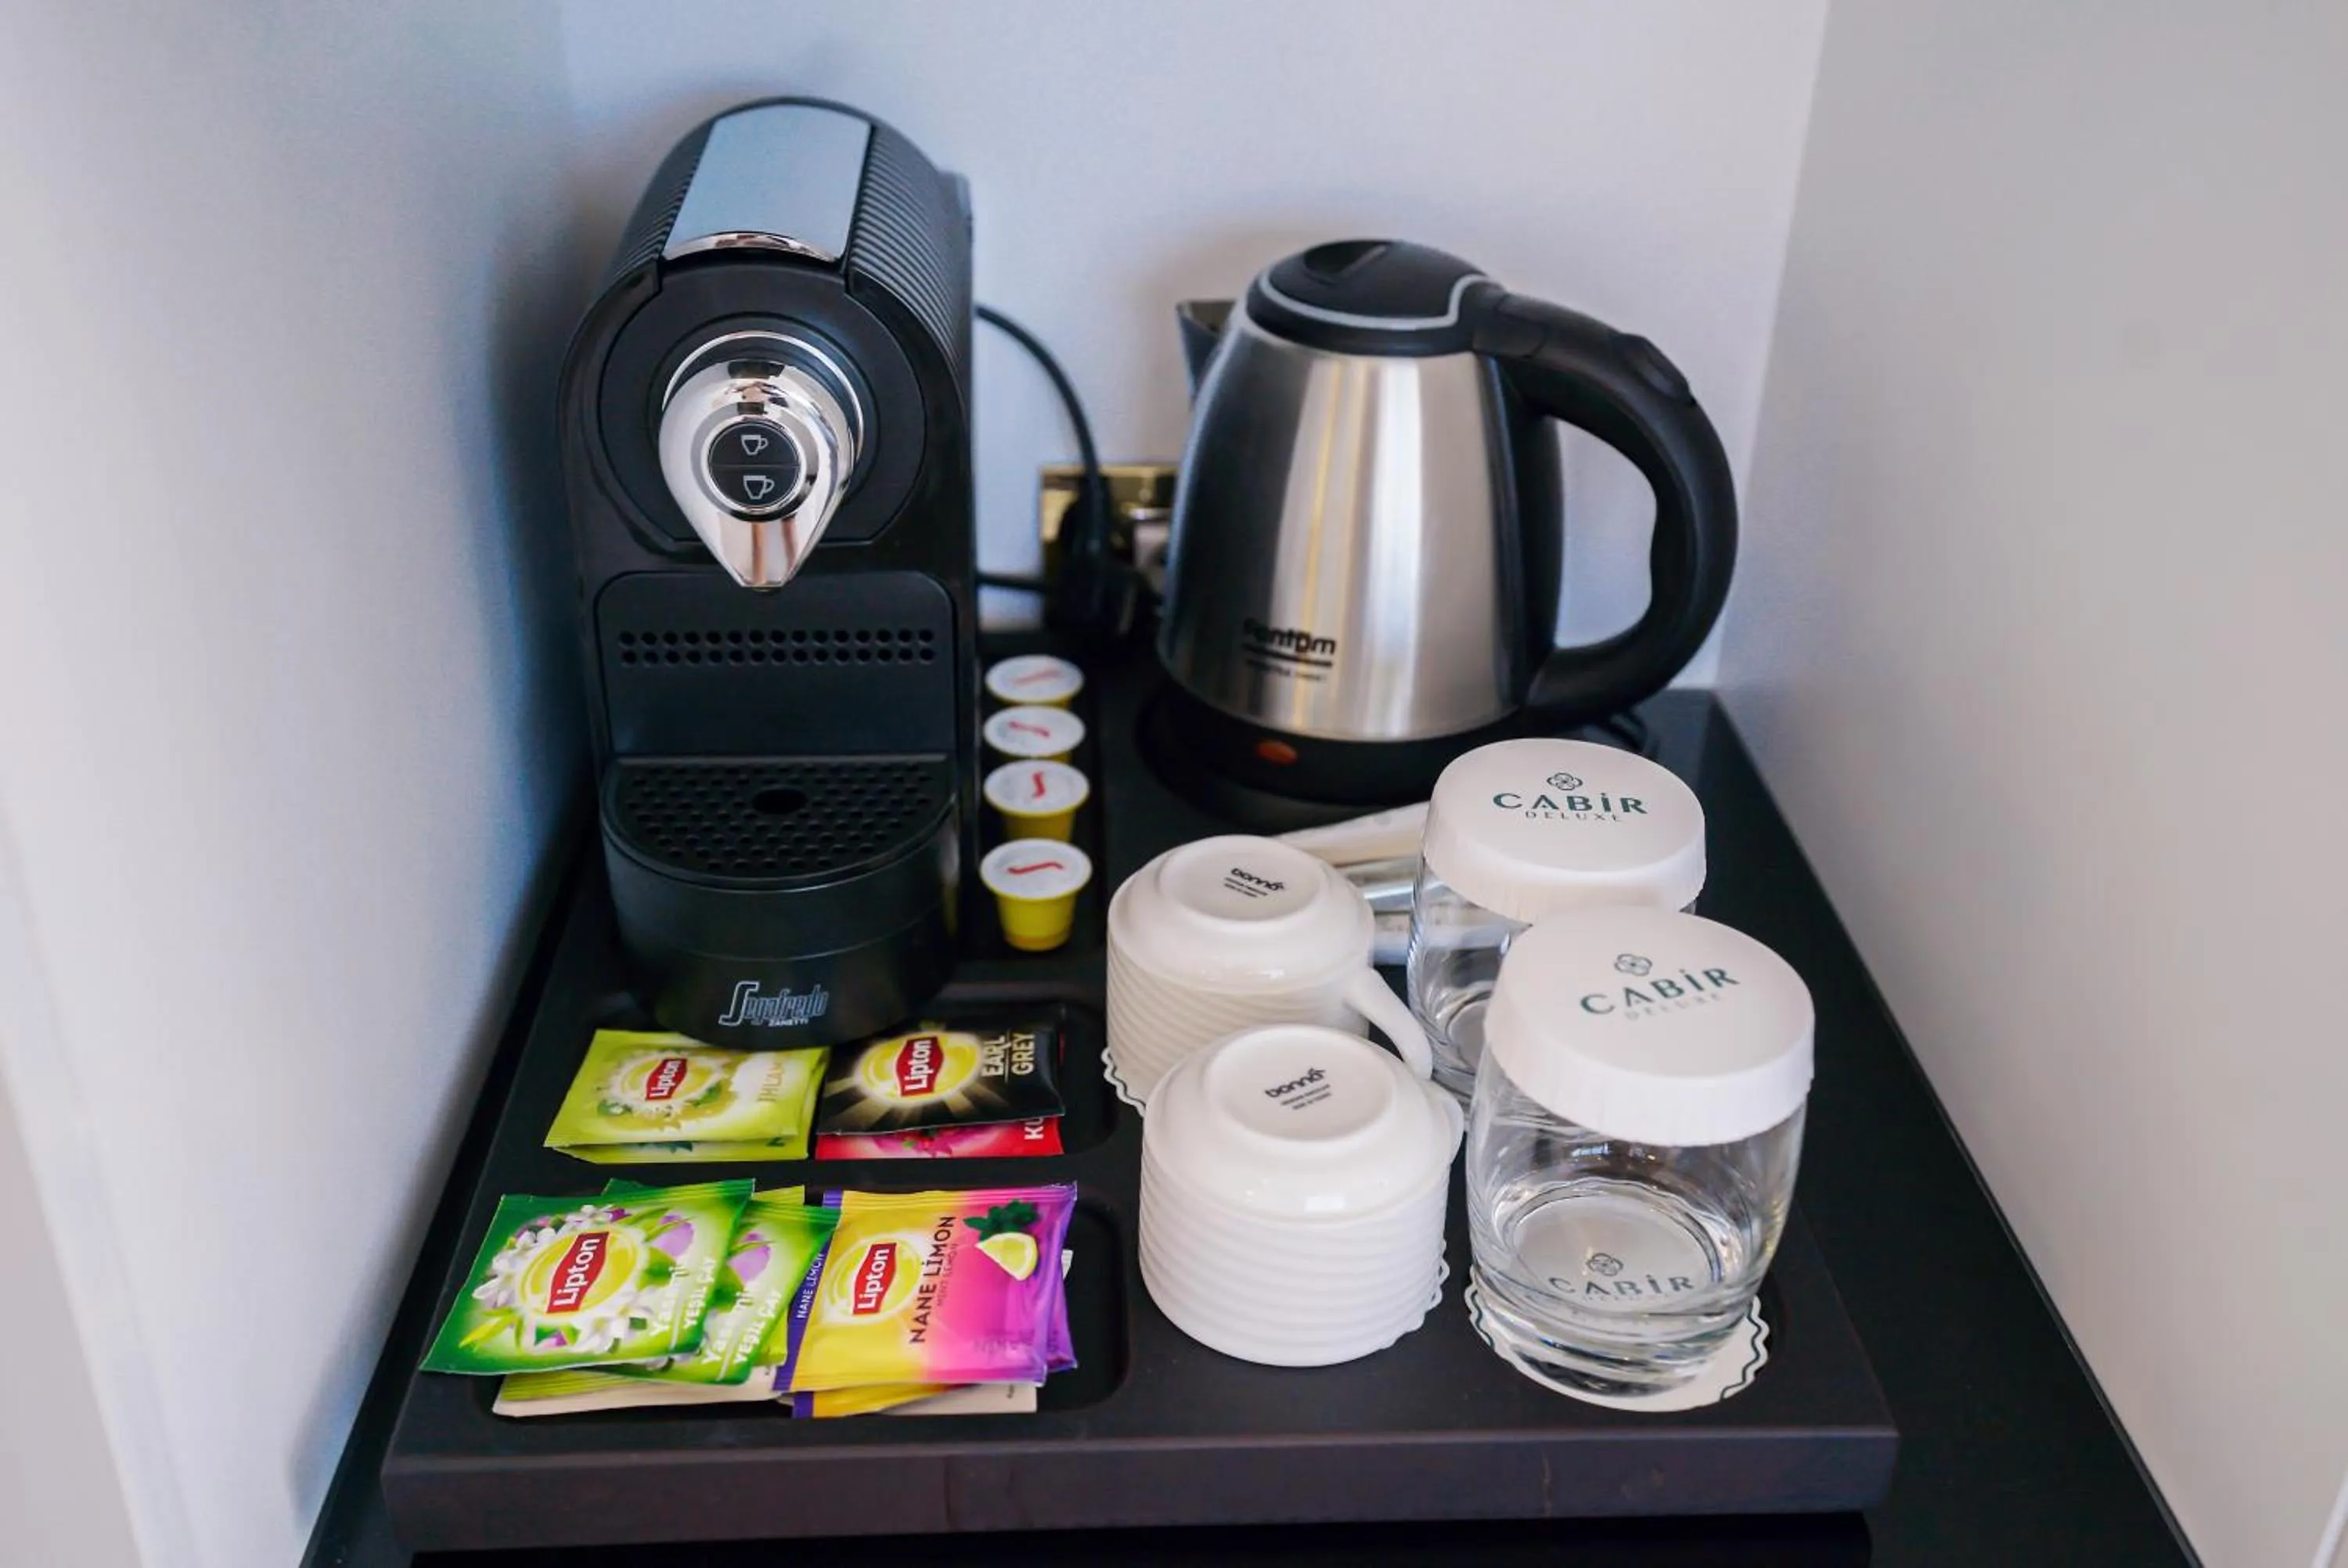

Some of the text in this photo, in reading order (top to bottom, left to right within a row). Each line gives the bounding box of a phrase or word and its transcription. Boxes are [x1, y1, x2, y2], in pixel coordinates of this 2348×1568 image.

[1525, 811, 1622, 822] DELUXE
[904, 1040, 934, 1090] Lipton
[981, 1035, 1012, 1077] EARL
[1010, 1033, 1035, 1075] GREY
[649, 1060, 682, 1097] Lipton
[553, 1239, 600, 1306] Lipton
[857, 1249, 890, 1308] Lipton
[909, 1283, 938, 1344] NANE
